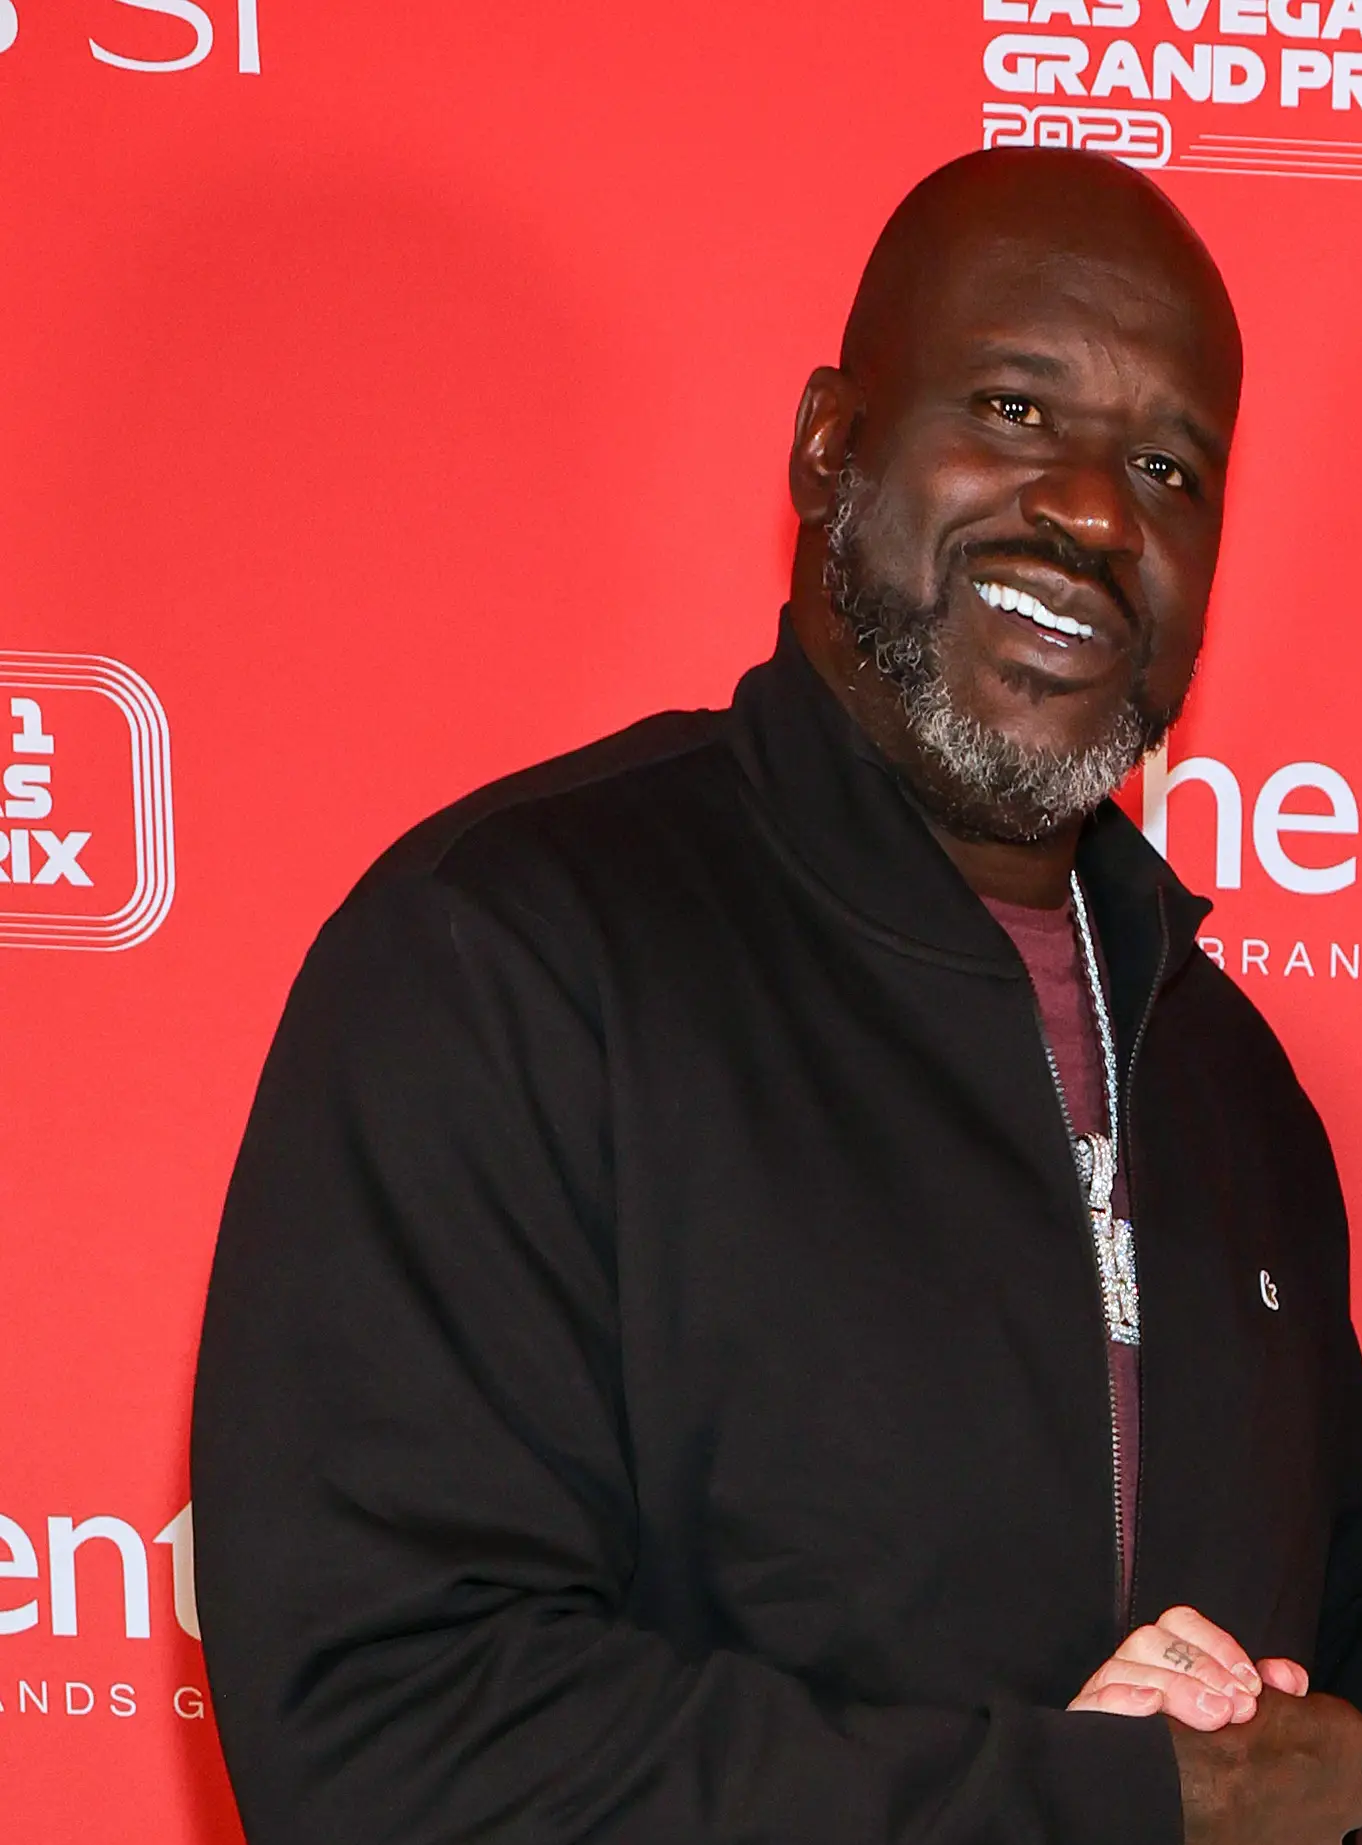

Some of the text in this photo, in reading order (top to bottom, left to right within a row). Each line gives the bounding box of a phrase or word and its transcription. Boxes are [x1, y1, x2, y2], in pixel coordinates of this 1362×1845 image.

[982, 33, 1266, 104] GRAND
[0, 764, 52, 819] S
[0, 829, 94, 886] IX
[0, 1680, 136, 1717] NDS
